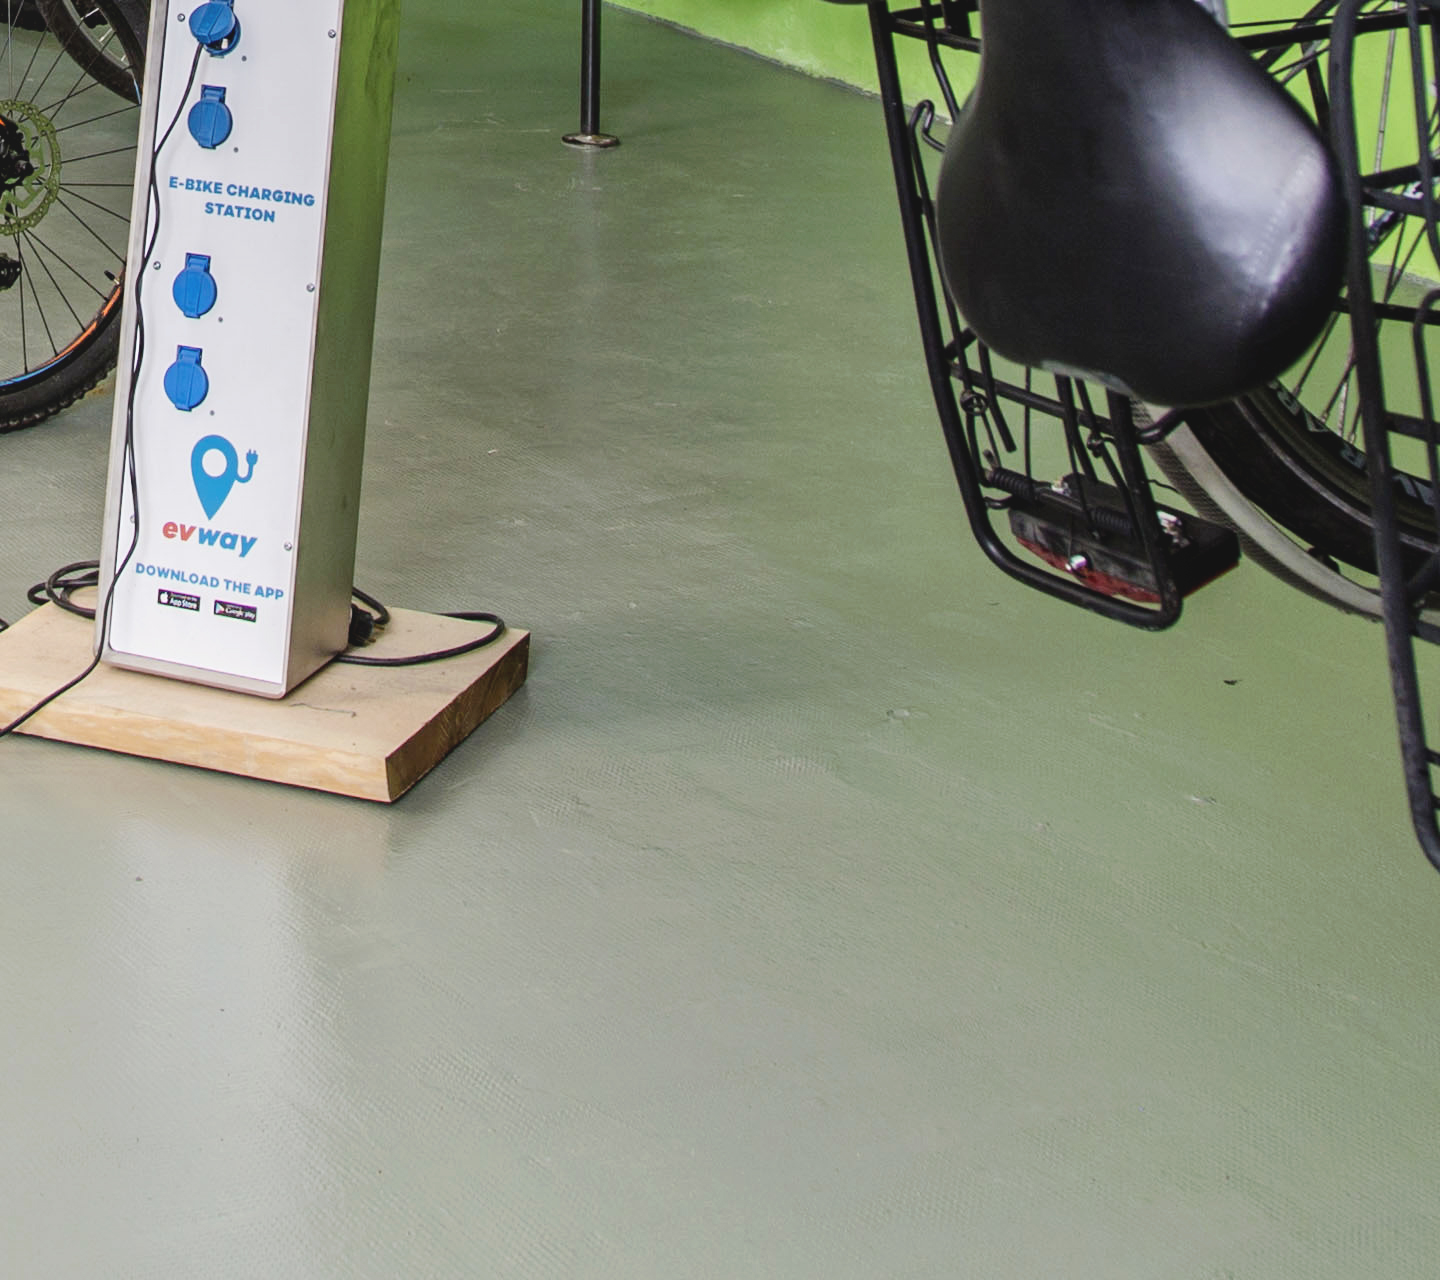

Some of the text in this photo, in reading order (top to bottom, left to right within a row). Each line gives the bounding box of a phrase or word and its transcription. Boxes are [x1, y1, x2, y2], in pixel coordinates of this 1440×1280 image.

[168, 175, 316, 208] E-BIKE CHARGING
[204, 201, 277, 225] STATION
[162, 521, 258, 558] evway
[135, 561, 285, 601] DOWNLOAD THE APP
